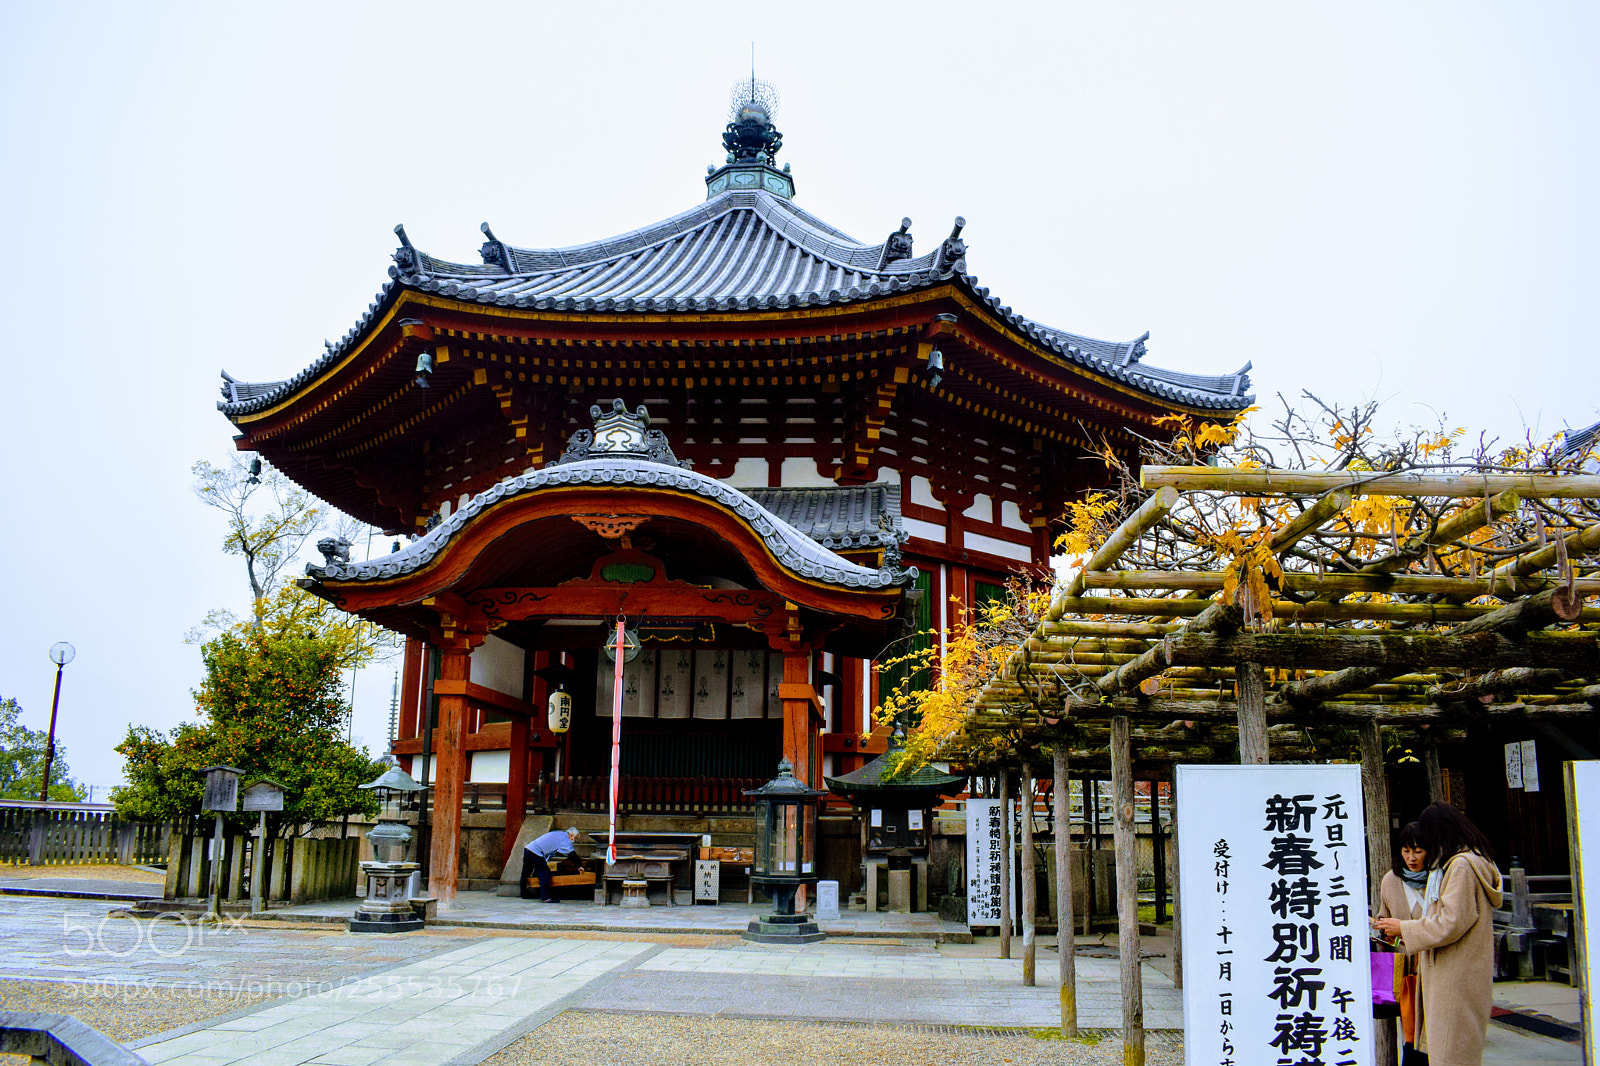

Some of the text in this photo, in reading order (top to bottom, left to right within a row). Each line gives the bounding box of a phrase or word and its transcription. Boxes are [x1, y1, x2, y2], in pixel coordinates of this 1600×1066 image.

[559, 695, 570, 729] 南円堂
[1263, 793, 1329, 1066] 新春特別祈祷
